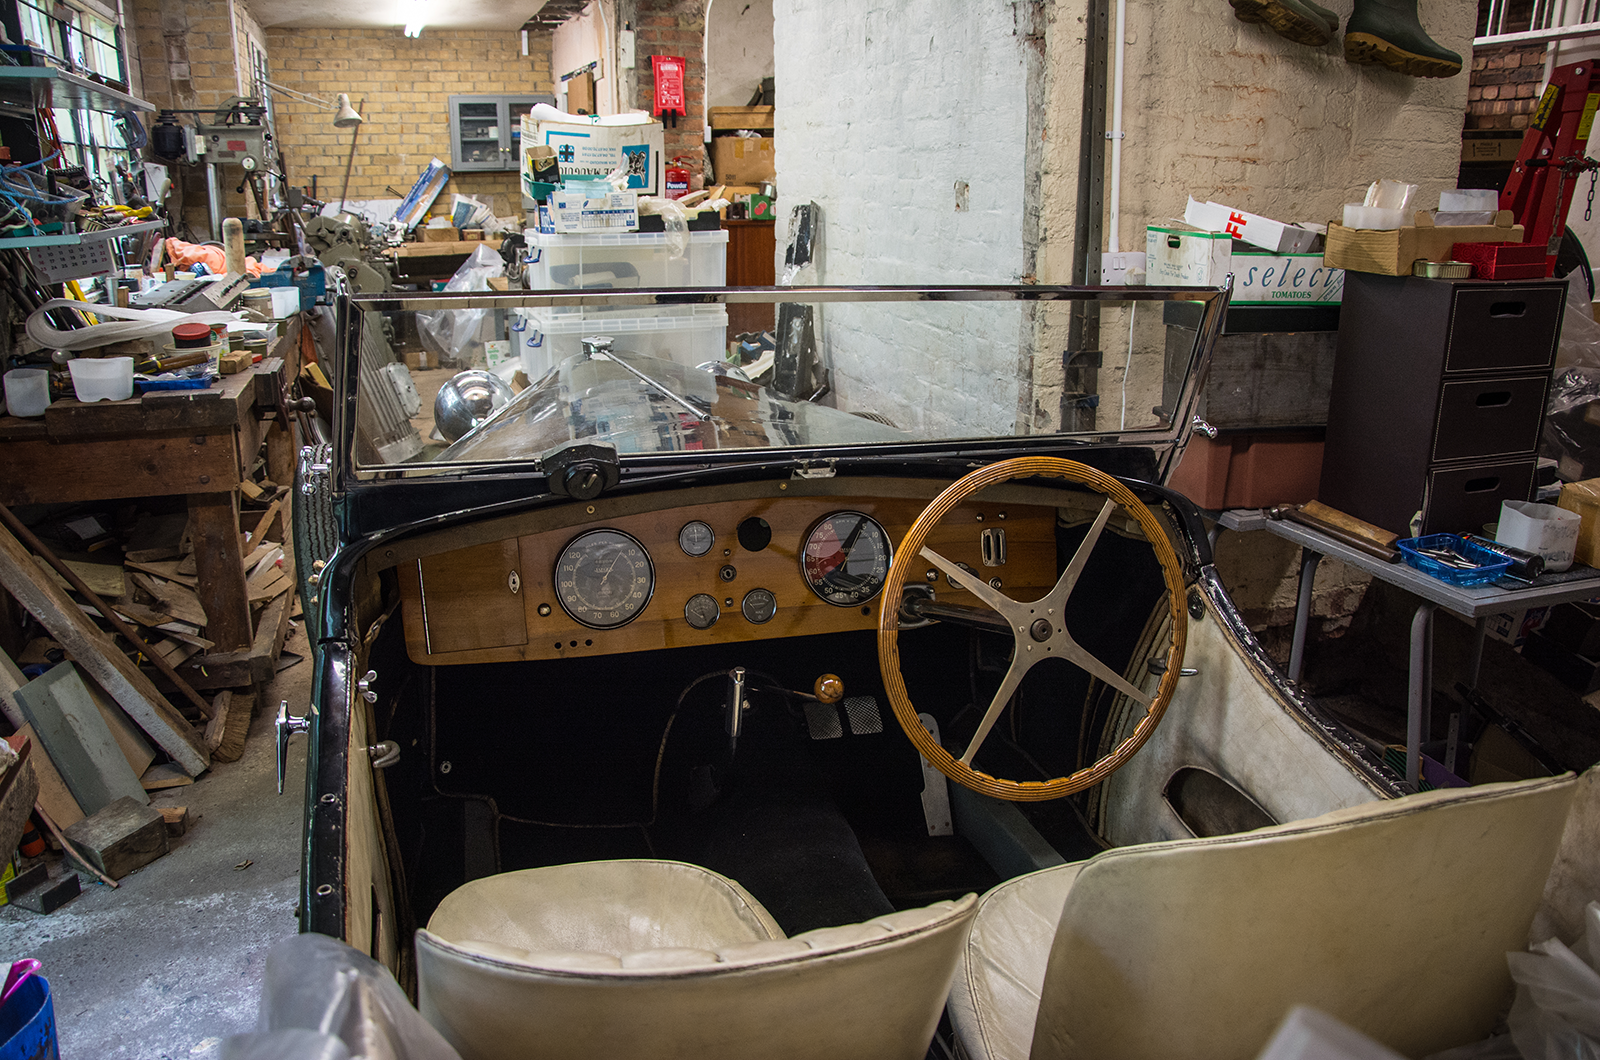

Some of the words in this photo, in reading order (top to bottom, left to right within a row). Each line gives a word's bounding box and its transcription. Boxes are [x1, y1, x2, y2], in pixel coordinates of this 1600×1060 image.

[1225, 211, 1247, 240] FF
[1243, 258, 1338, 288] select
[1271, 290, 1312, 299] TOMATOES
